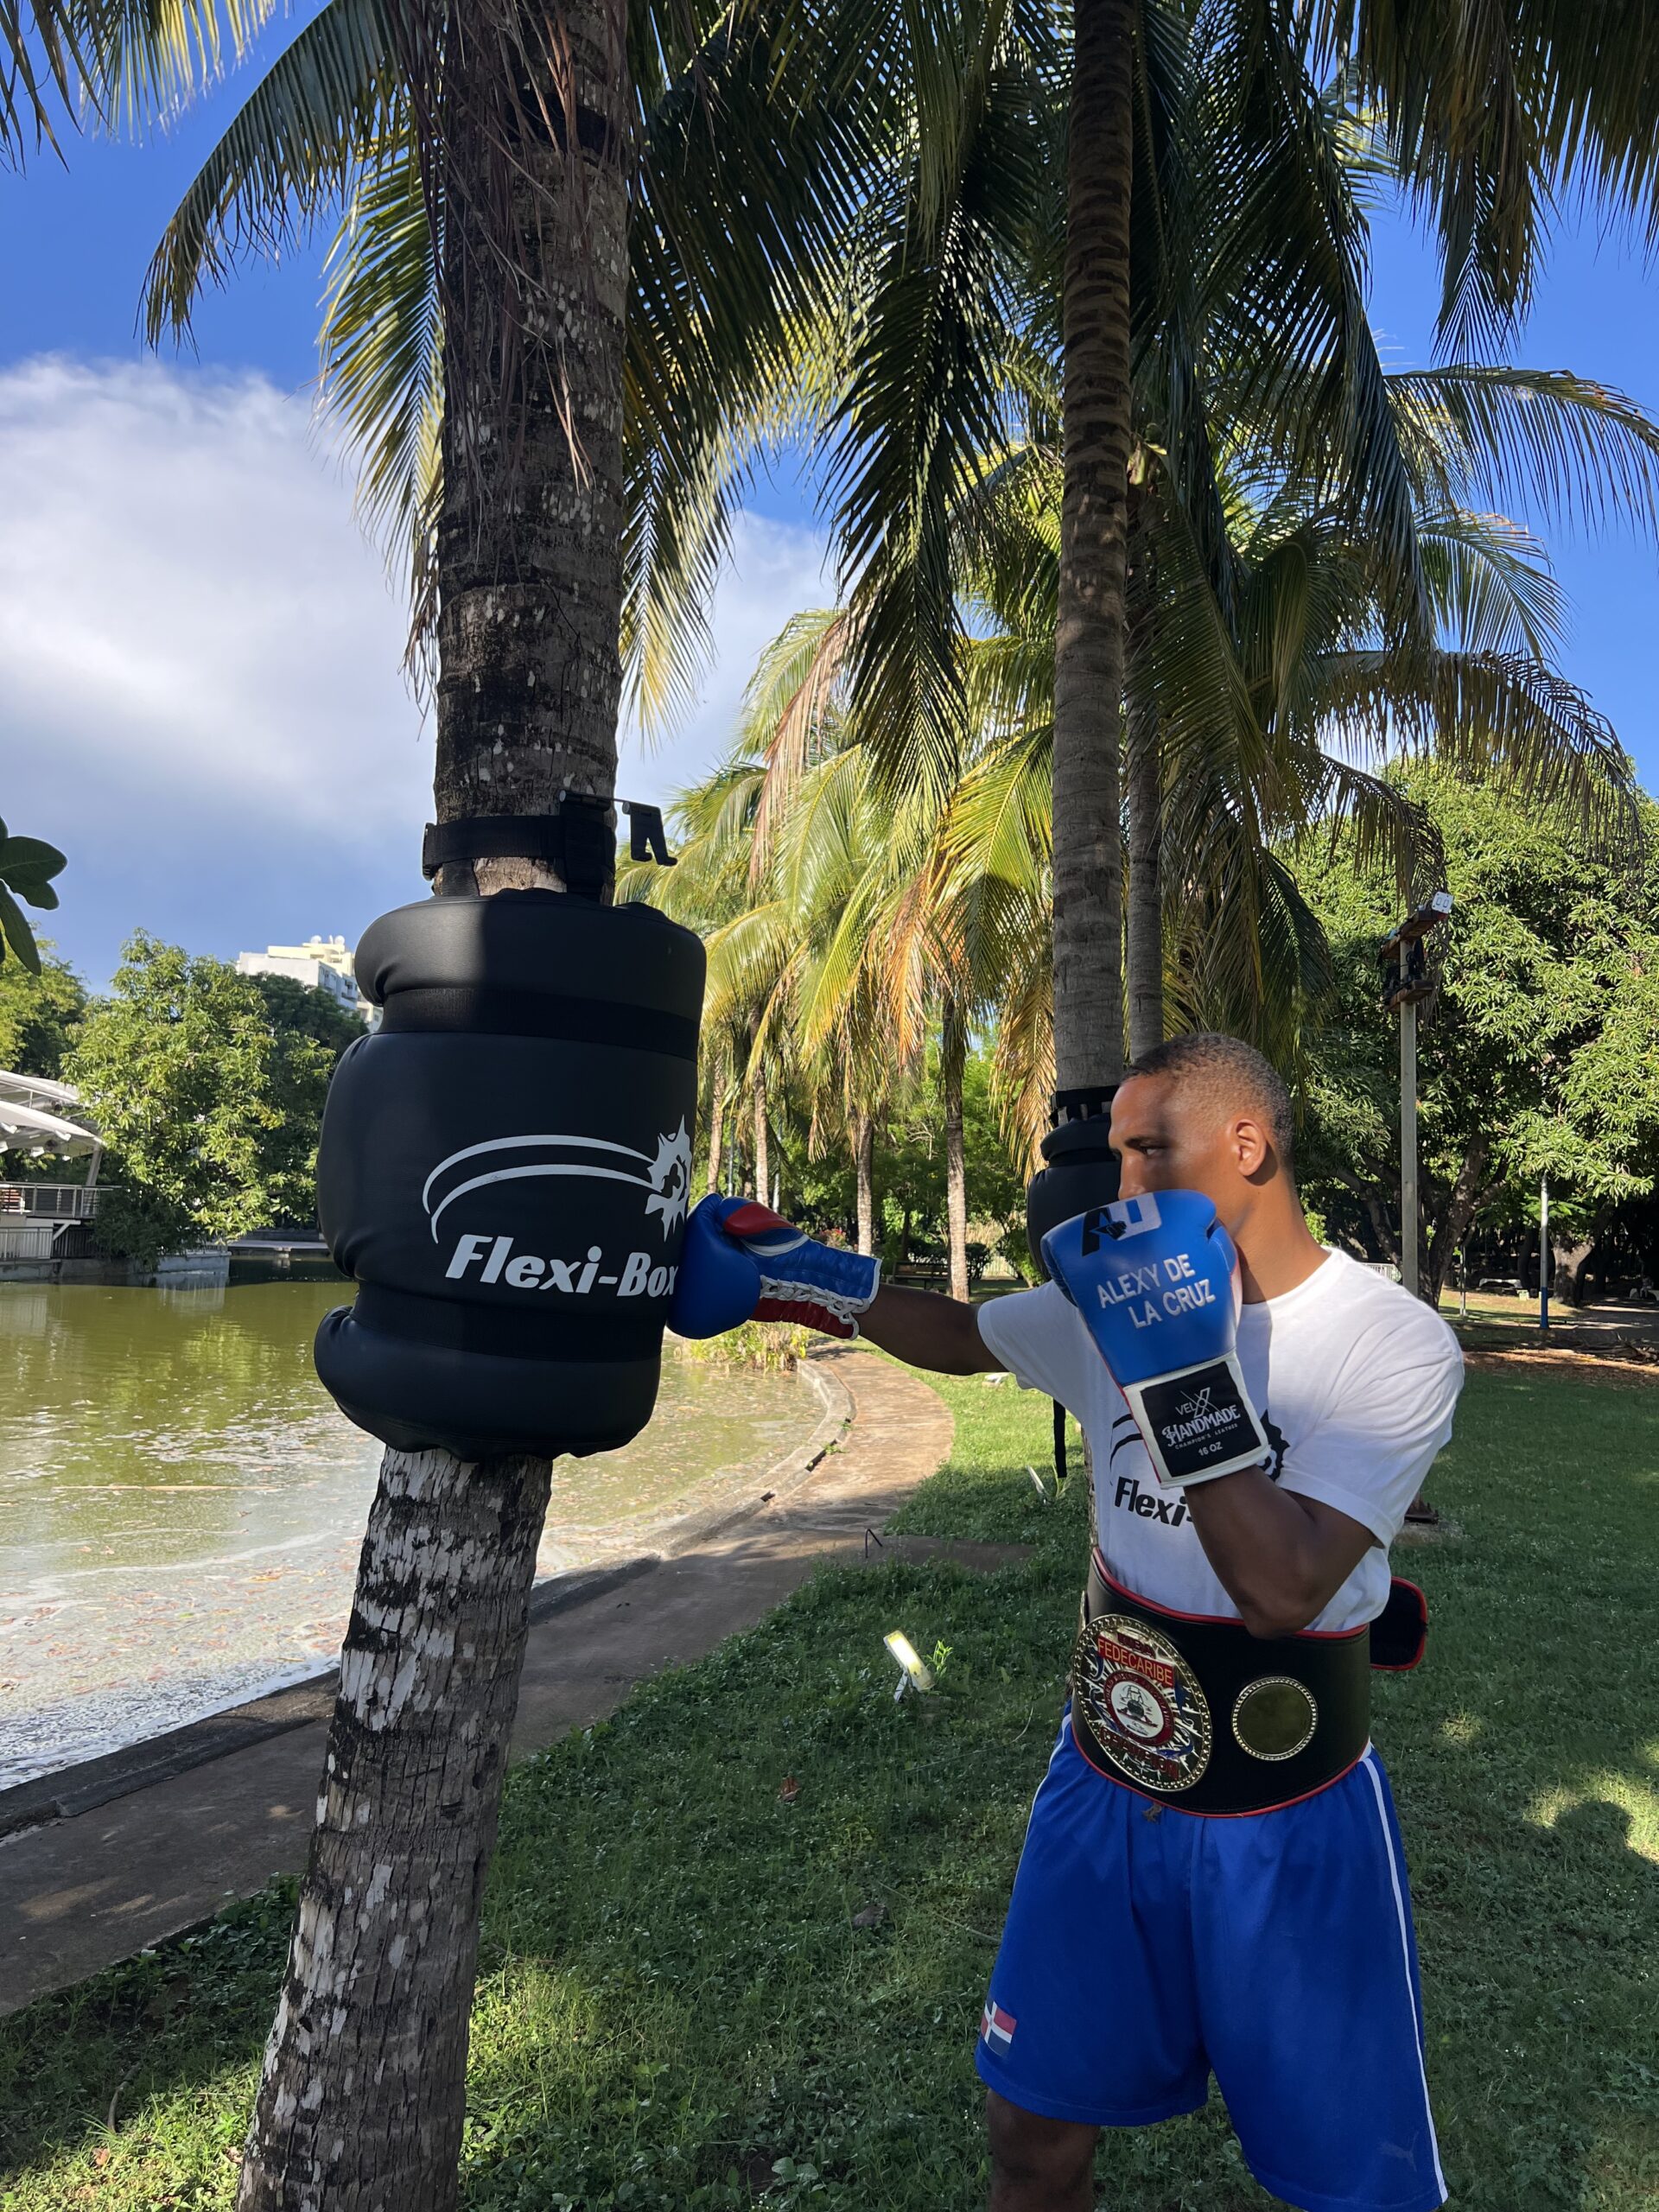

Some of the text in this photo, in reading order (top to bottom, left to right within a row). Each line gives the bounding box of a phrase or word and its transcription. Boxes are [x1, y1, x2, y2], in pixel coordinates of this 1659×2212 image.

[445, 1234, 679, 1297] Flexi-Box
[1096, 1254, 1196, 1308] ALEXY DE
[1128, 1279, 1217, 1329] LA CRUZ
[1161, 1405, 1241, 1447] HANDMADE
[1198, 1441, 1224, 1456] 16 OZ
[1214, 1423, 1238, 1435] LEATHER
[1098, 1638, 1173, 1686] FEDECARIBE
